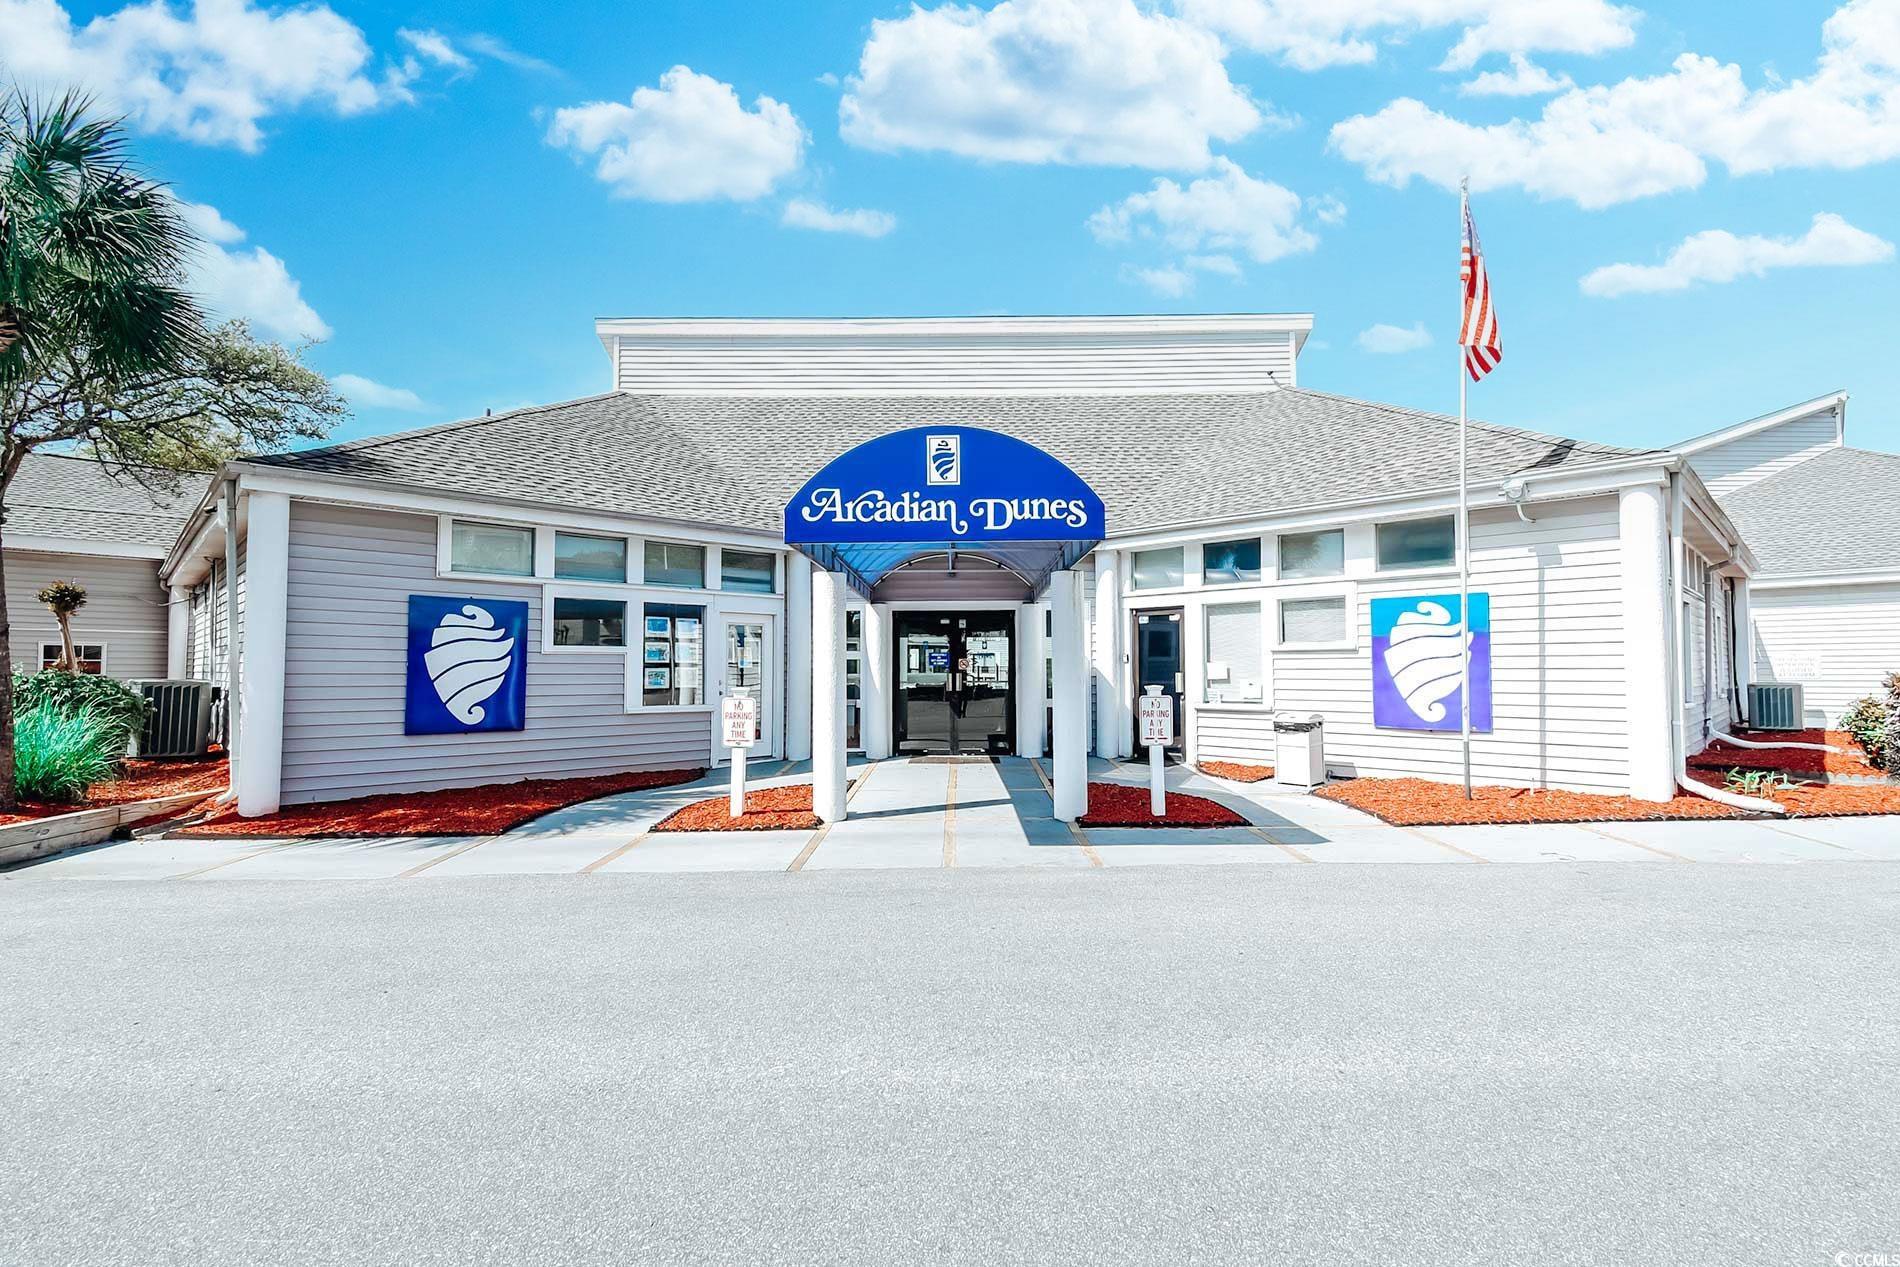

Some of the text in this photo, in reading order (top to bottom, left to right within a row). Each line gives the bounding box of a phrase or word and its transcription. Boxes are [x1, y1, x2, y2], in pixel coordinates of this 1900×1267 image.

[801, 487, 1088, 535] Arcadian Dunes
[724, 711, 753, 720] PARKING
[731, 721, 746, 729] ANY
[1149, 719, 1163, 727] AY
[731, 730, 747, 739] TIME
